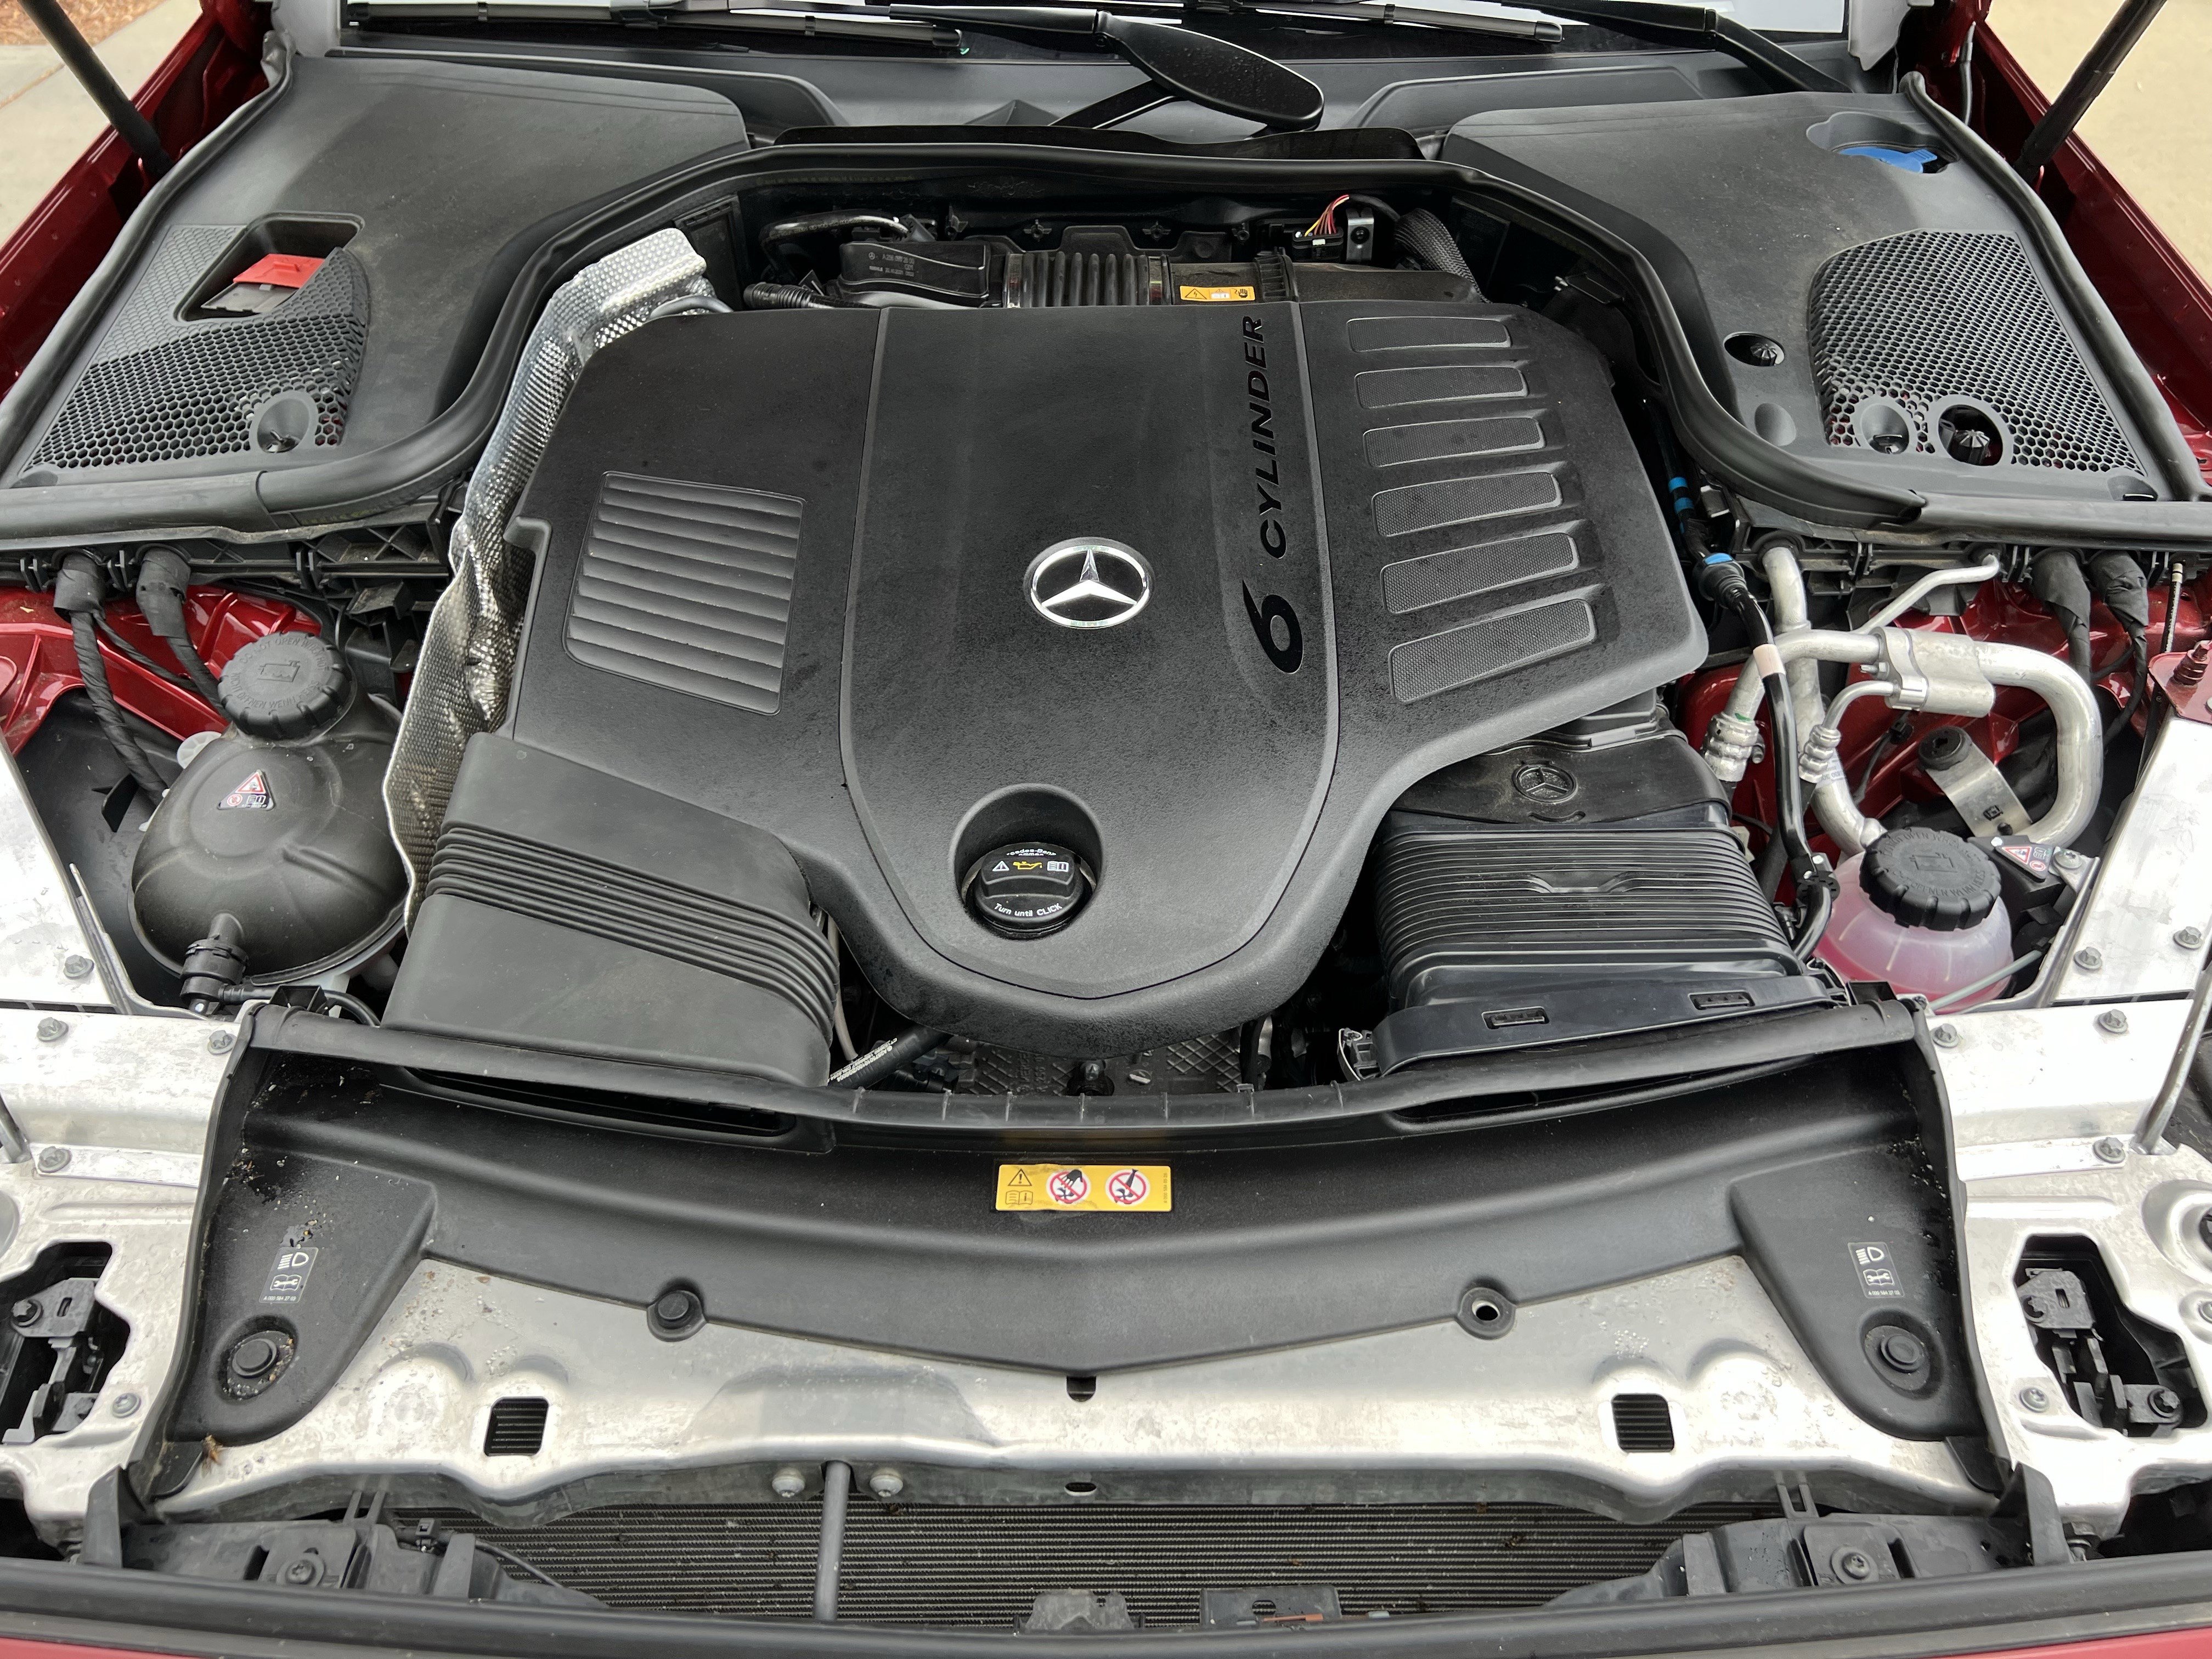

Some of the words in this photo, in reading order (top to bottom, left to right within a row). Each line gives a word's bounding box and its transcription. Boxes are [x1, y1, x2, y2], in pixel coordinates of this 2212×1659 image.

[1242, 315, 1287, 560] CYLINDER
[275, 637, 300, 646] OPEN
[301, 639, 325, 656] WHEN
[1242, 579, 1304, 675] 6
[994, 902, 1012, 915] Turn
[1036, 902, 1063, 916] CLICK
